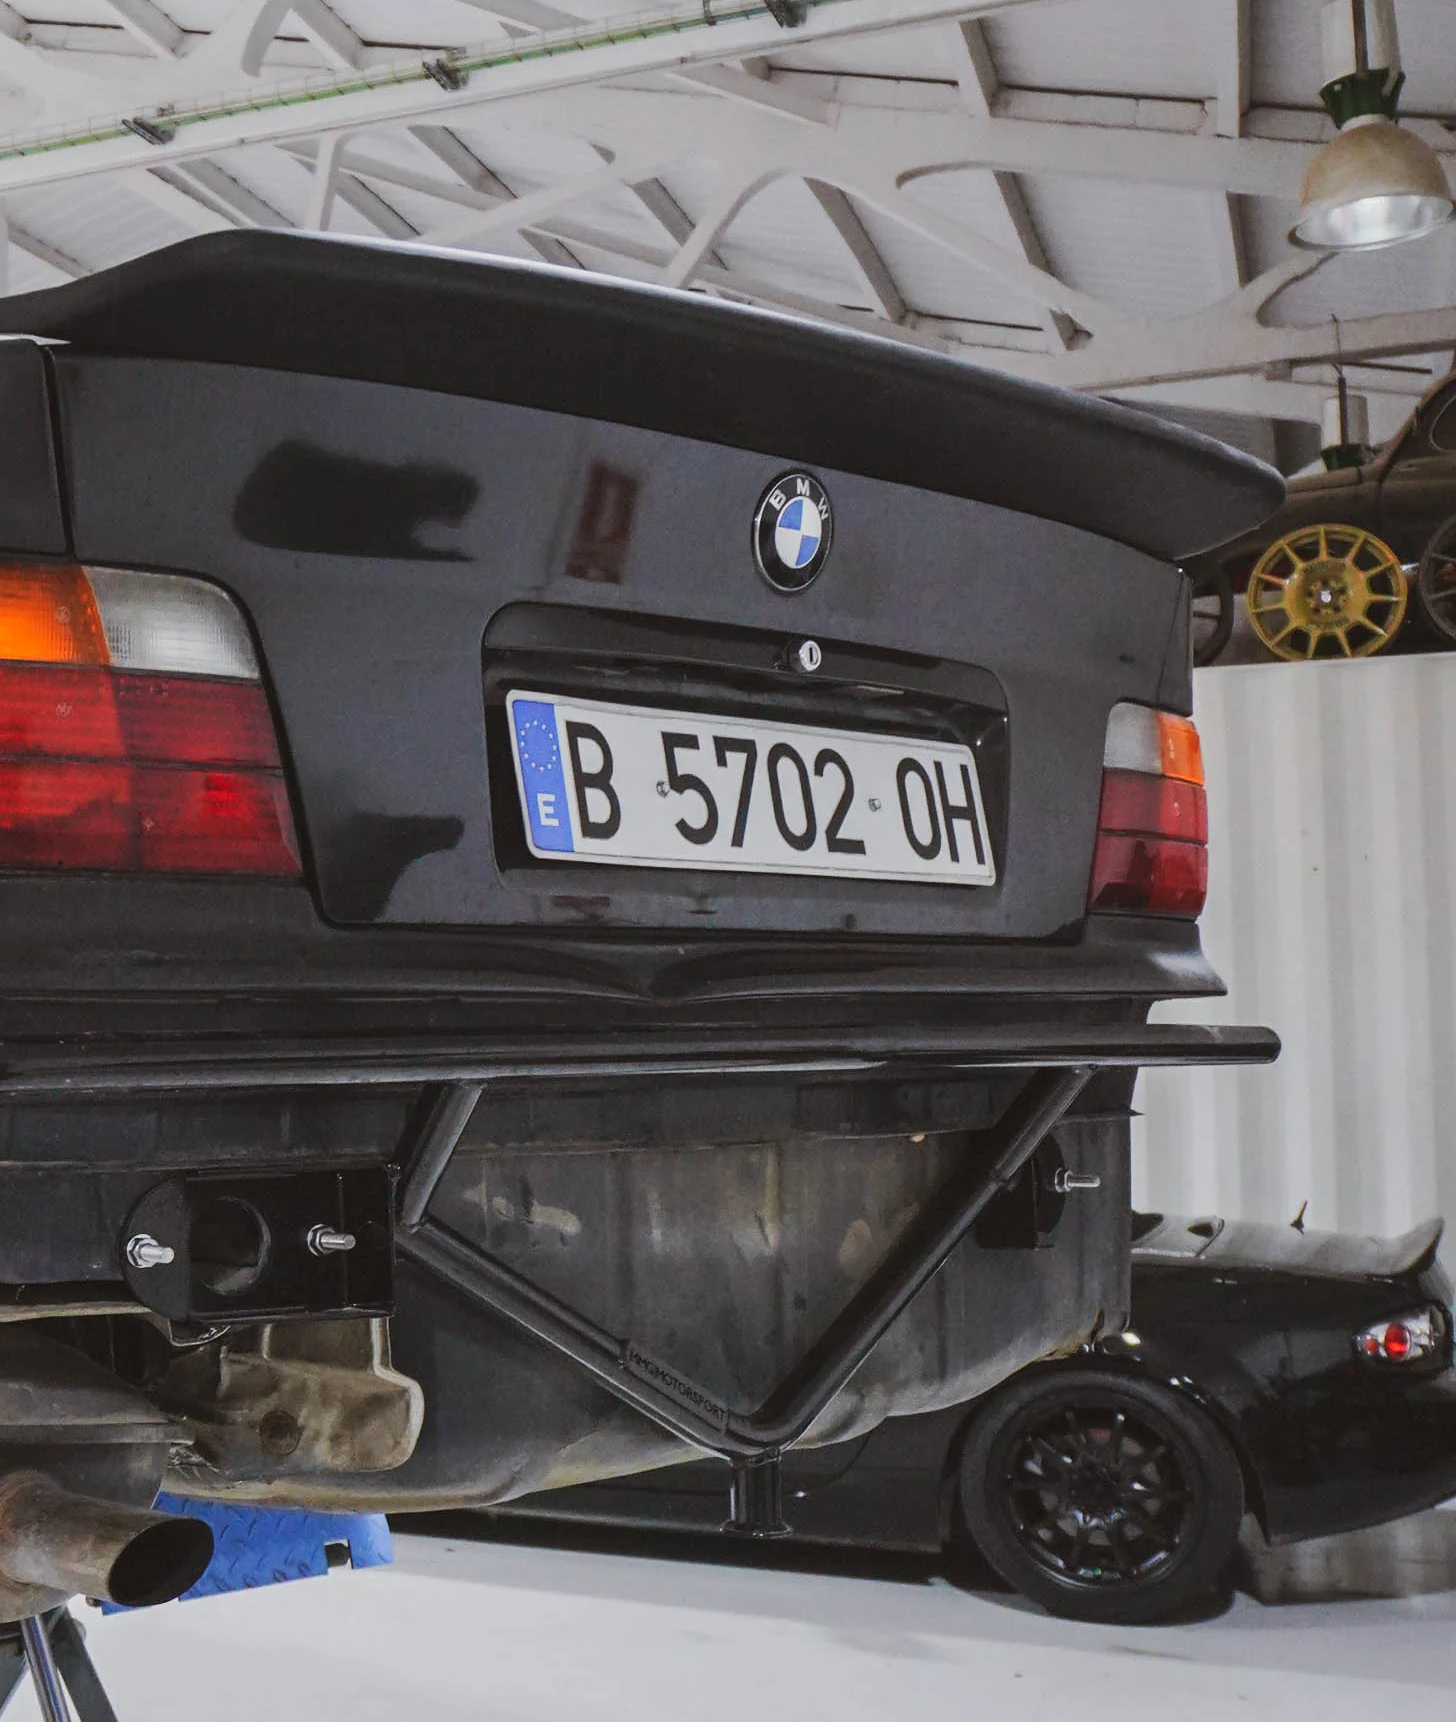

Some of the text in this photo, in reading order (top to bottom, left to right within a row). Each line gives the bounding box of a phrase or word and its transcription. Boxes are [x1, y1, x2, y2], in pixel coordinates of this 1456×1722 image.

[768, 477, 829, 521] BMW
[565, 720, 622, 840] B
[660, 730, 867, 855] 5702
[536, 792, 560, 828] E
